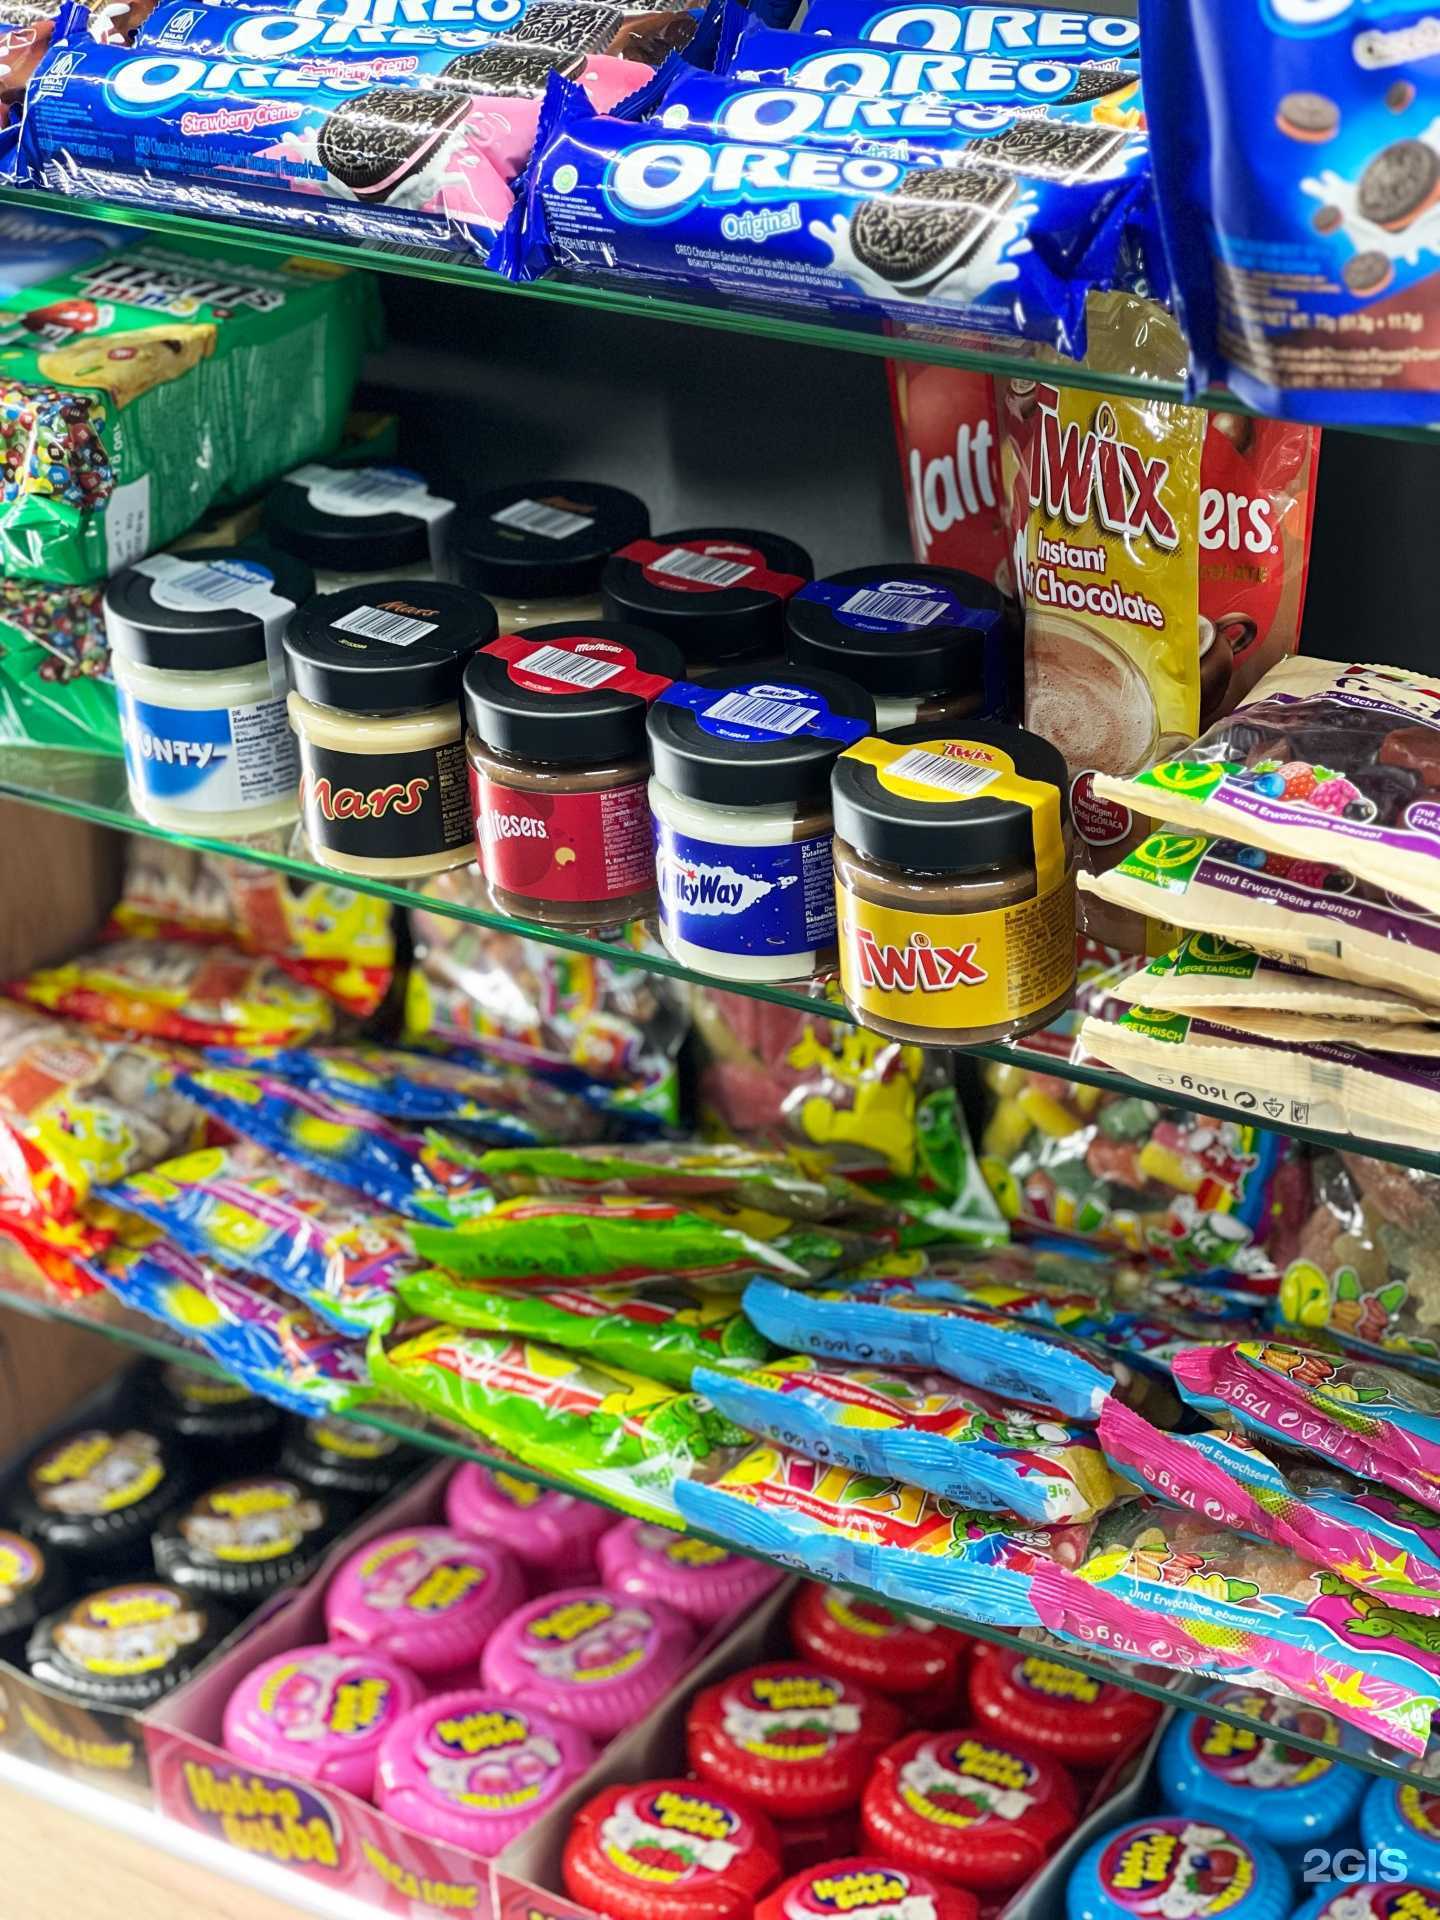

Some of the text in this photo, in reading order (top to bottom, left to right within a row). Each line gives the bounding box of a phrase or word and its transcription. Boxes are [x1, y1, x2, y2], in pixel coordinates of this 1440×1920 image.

[234, 15, 492, 54] OREO
[869, 8, 1140, 53] OREO
[373, 55, 417, 74] Creme
[804, 52, 1073, 97] OREO
[183, 104, 300, 133] Strawberry Creme
[726, 88, 1009, 143] OREO
[612, 142, 901, 211] OREO
[722, 203, 801, 241] Original
[675, 244, 692, 255] OREO
[692, 246, 719, 260] Chocolate
[719, 250, 748, 264] Sandwich
[748, 254, 771, 268] Cookies
[1029, 382, 1180, 551] Twix
[1037, 529, 1107, 573] Instant
[1035, 568, 1164, 629] Chocolate
[140, 735, 214, 769] UNTY
[944, 742, 995, 764] Twix
[300, 775, 430, 822] Mars
[1415, 806, 1436, 819] mit
[476, 808, 551, 842] ltesers
[1232, 798, 1258, 812] und
[1258, 806, 1331, 828] Erwachsene
[1331, 823, 1384, 840] ebenso!
[676, 874, 744, 907] lkyWay
[1214, 871, 1239, 886] und
[1240, 877, 1312, 909] Erwachsene
[1312, 899, 1362, 921] ebenso!
[850, 930, 989, 991] Twix
[1178, 964, 1252, 977] VEGETARISCH
[1126, 1021, 1184, 1042] GETARISCH
[1180, 1074, 1229, 1102] 160 g
[1191, 1439, 1214, 1456] und
[763, 1488, 786, 1502] und
[1158, 1470, 1196, 1507] 175 g
[1129, 1588, 1151, 1603] und
[1214, 1609, 1262, 1627] ebenso!
[1095, 1625, 1141, 1654] 175 g
